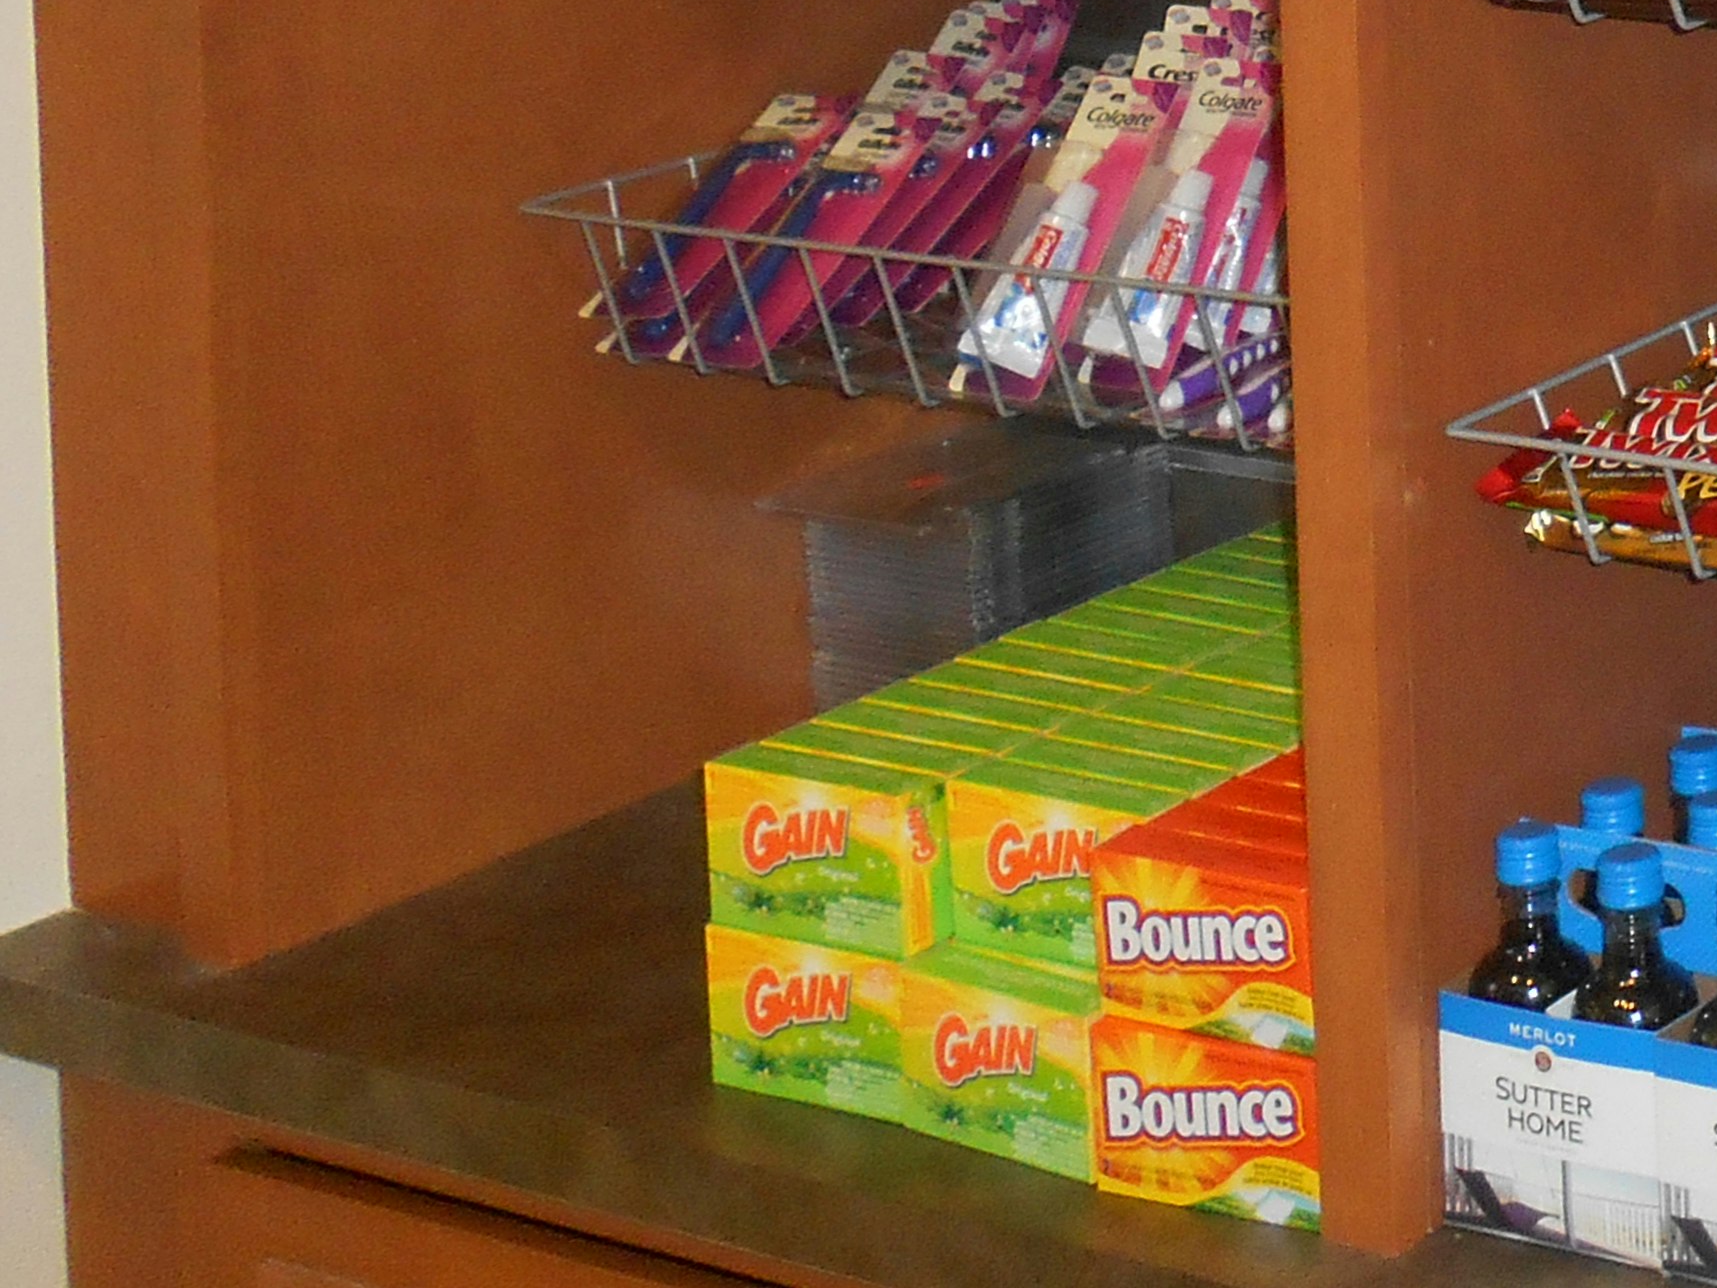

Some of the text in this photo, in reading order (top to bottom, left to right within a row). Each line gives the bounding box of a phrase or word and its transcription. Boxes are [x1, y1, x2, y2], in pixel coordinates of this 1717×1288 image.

[1086, 106, 1155, 128] Colgate
[1198, 91, 1263, 112] Colgate
[743, 804, 848, 875] GAIN
[986, 824, 1096, 894] GAIN
[1106, 900, 1286, 964] Bounce
[744, 966, 850, 1037] GAIN
[934, 1013, 1036, 1087] GAIN
[1508, 1023, 1578, 1048] MERLOT
[1106, 1077, 1294, 1139] Bounce
[1495, 1076, 1594, 1120] SUTTER
[1506, 1107, 1585, 1145] HOME
